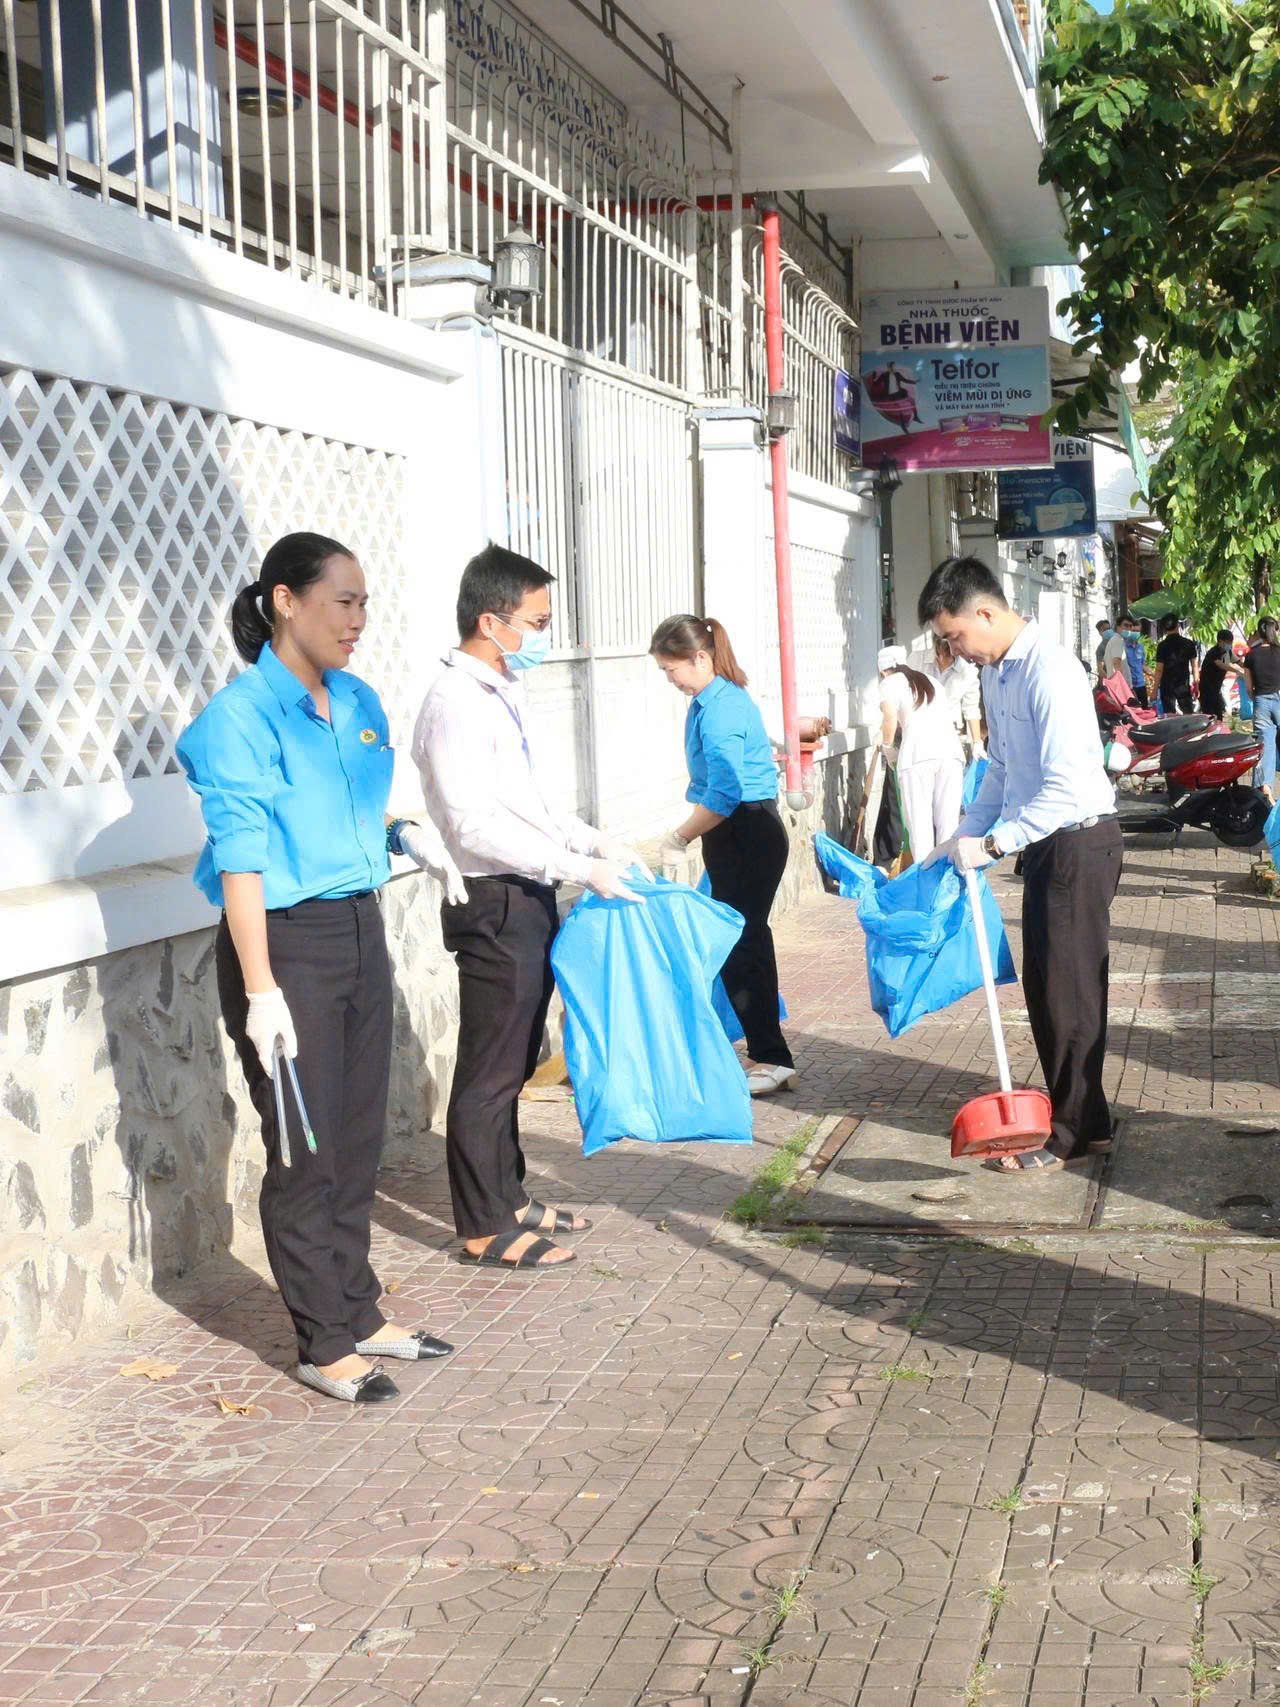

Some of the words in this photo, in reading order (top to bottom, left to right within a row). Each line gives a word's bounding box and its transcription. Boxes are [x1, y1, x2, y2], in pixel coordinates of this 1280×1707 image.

[909, 307, 938, 319] NHÀ
[942, 304, 990, 318] THUỐC
[880, 319, 951, 350] BỆNH
[959, 316, 1020, 346] VIỆN
[930, 358, 1000, 380] Telfor
[935, 389, 963, 402] VIÊM
[966, 389, 987, 401] MÙI
[991, 390, 1003, 402] DỊ
[1006, 387, 1032, 400] ỨNG
